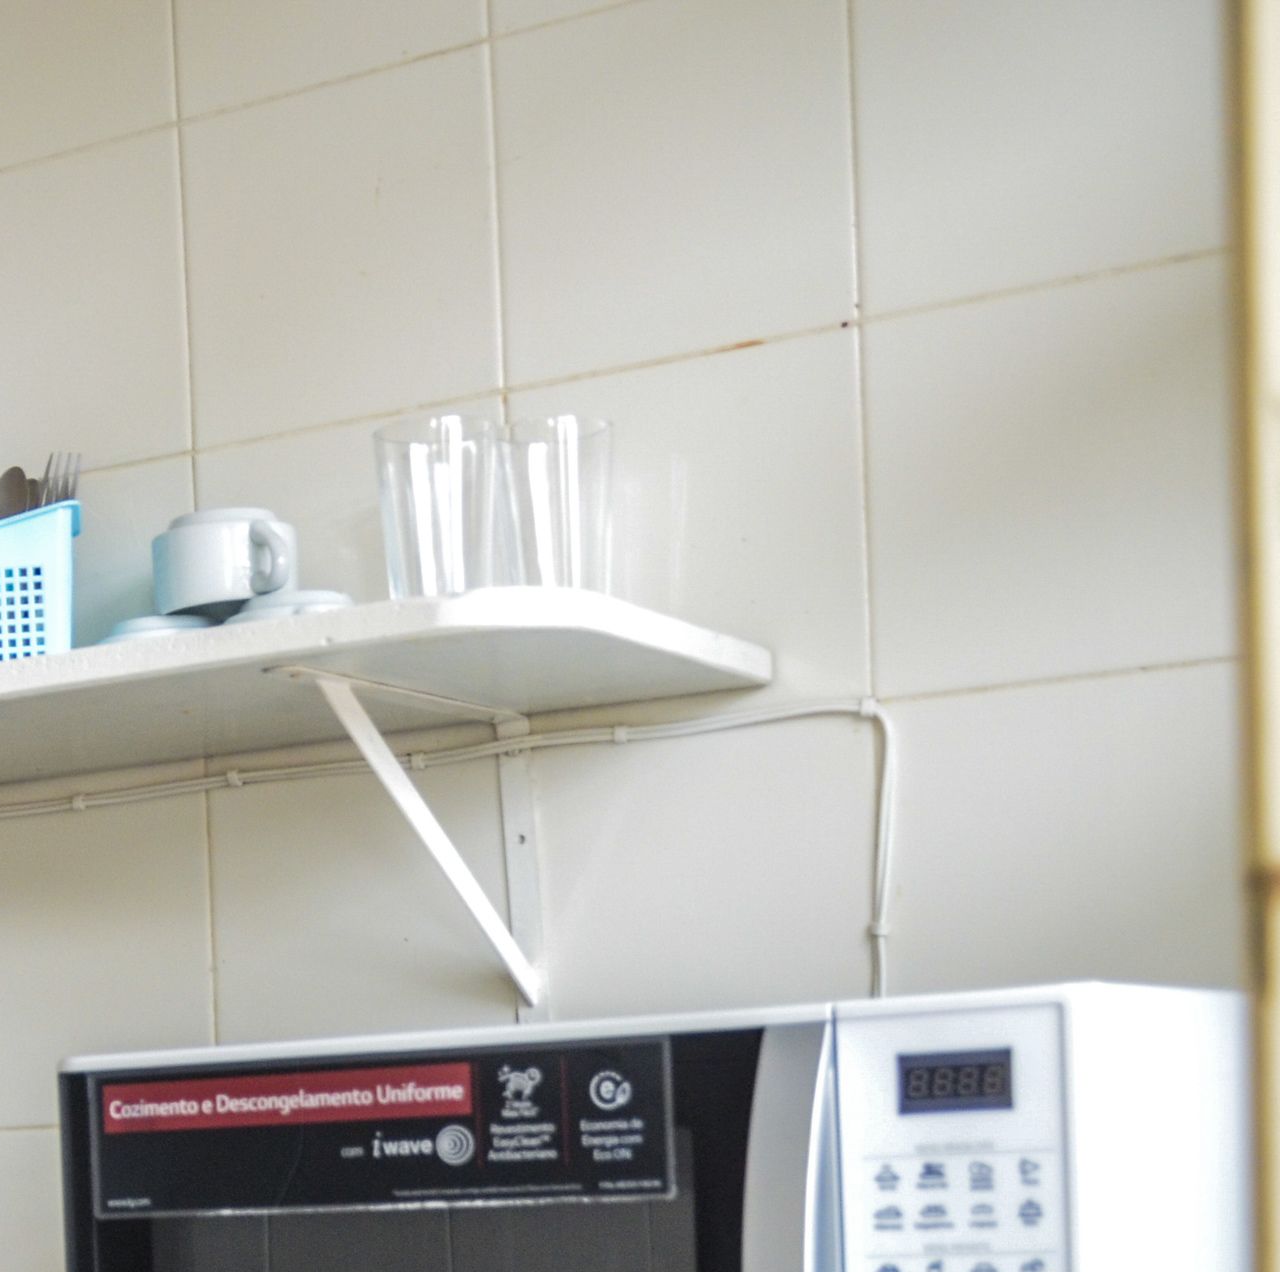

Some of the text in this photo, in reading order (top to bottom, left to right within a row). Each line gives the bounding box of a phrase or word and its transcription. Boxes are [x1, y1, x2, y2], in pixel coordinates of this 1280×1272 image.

[109, 1082, 465, 1120] Cozimento e Descongelamento Uniforme
